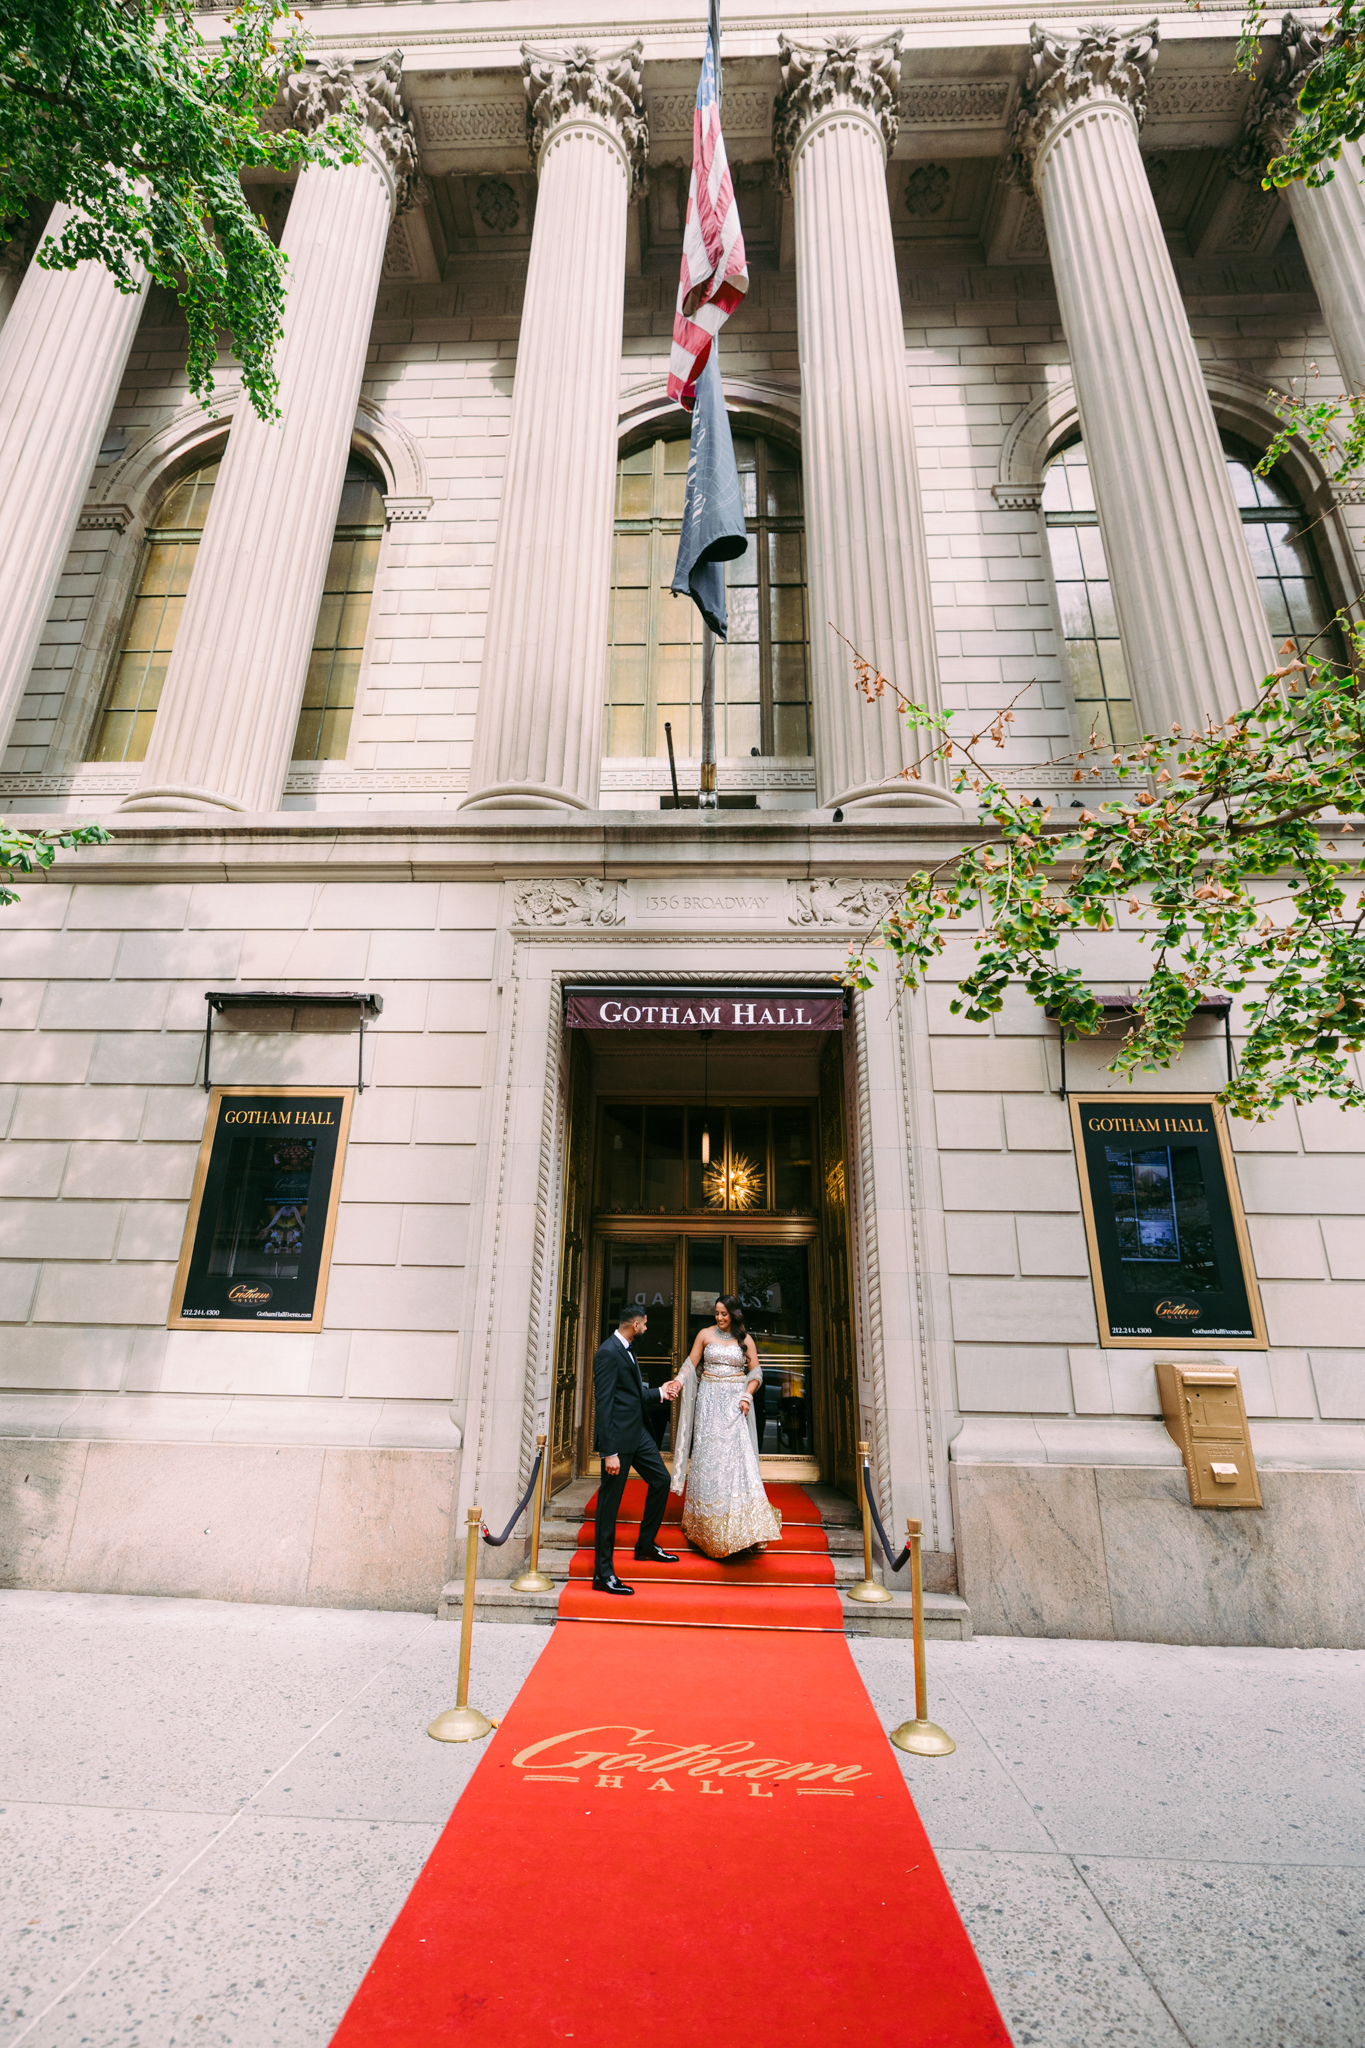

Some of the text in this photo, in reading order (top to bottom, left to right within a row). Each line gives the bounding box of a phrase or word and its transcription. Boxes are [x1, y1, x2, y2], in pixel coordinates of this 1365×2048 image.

[645, 895, 769, 910] 1356 BROADWAY
[600, 1001, 812, 1025] GOTHAM HALL
[224, 1111, 335, 1125] GOTHAM HALL
[1088, 1118, 1209, 1133] GOTHAM HALL
[229, 1285, 270, 1299] Gotham
[1155, 1300, 1200, 1315] Gotham
[511, 1725, 872, 1783] Gotham
[595, 1775, 773, 1798] HALL
